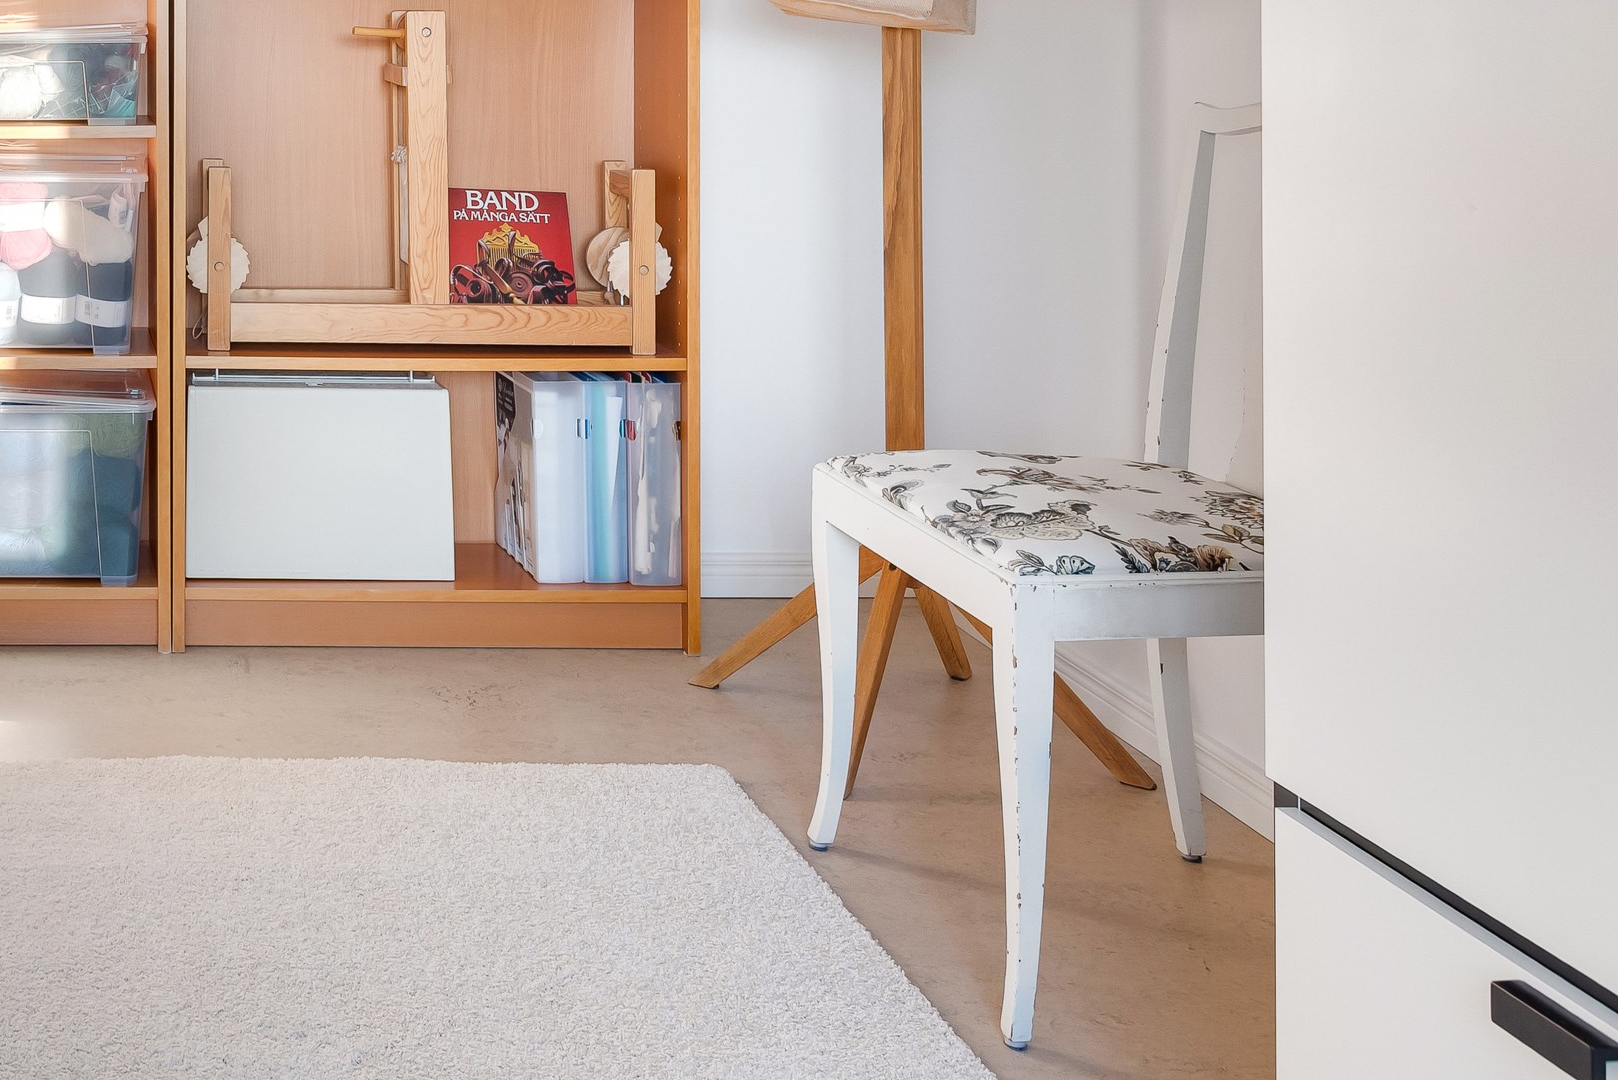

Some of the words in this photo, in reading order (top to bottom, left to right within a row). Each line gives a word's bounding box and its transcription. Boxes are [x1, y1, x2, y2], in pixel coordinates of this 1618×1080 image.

[465, 190, 539, 212] BAND
[453, 208, 469, 221] PÅ
[470, 208, 518, 223] MÅNGA
[519, 211, 550, 224] SÄTT
